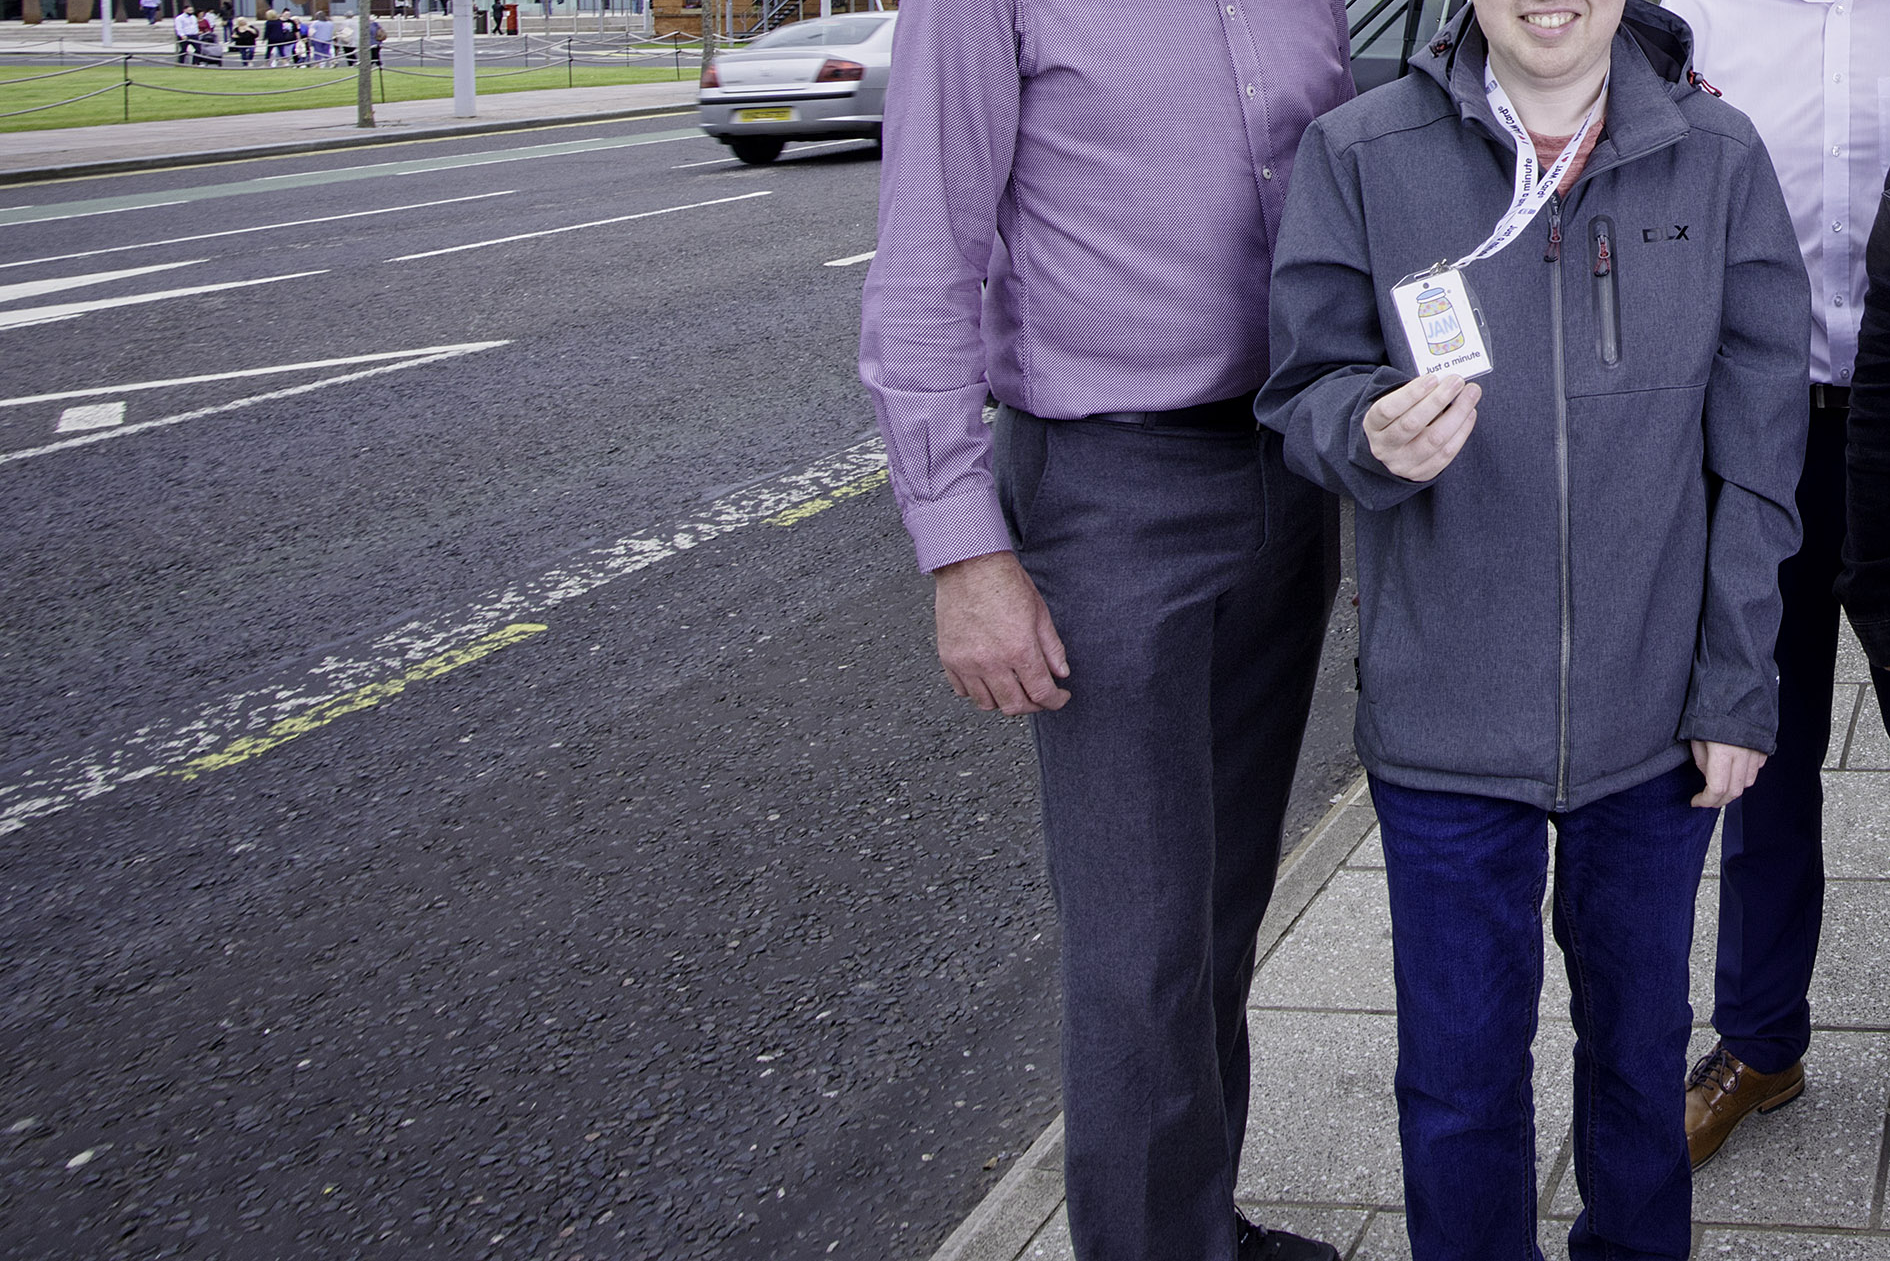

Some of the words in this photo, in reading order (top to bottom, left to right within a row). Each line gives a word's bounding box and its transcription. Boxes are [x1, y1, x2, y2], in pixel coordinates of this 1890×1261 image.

[1522, 158, 1533, 192] minute
[1428, 315, 1458, 339] JAM
[1426, 363, 1442, 375] Just
[1452, 351, 1481, 366] minute
